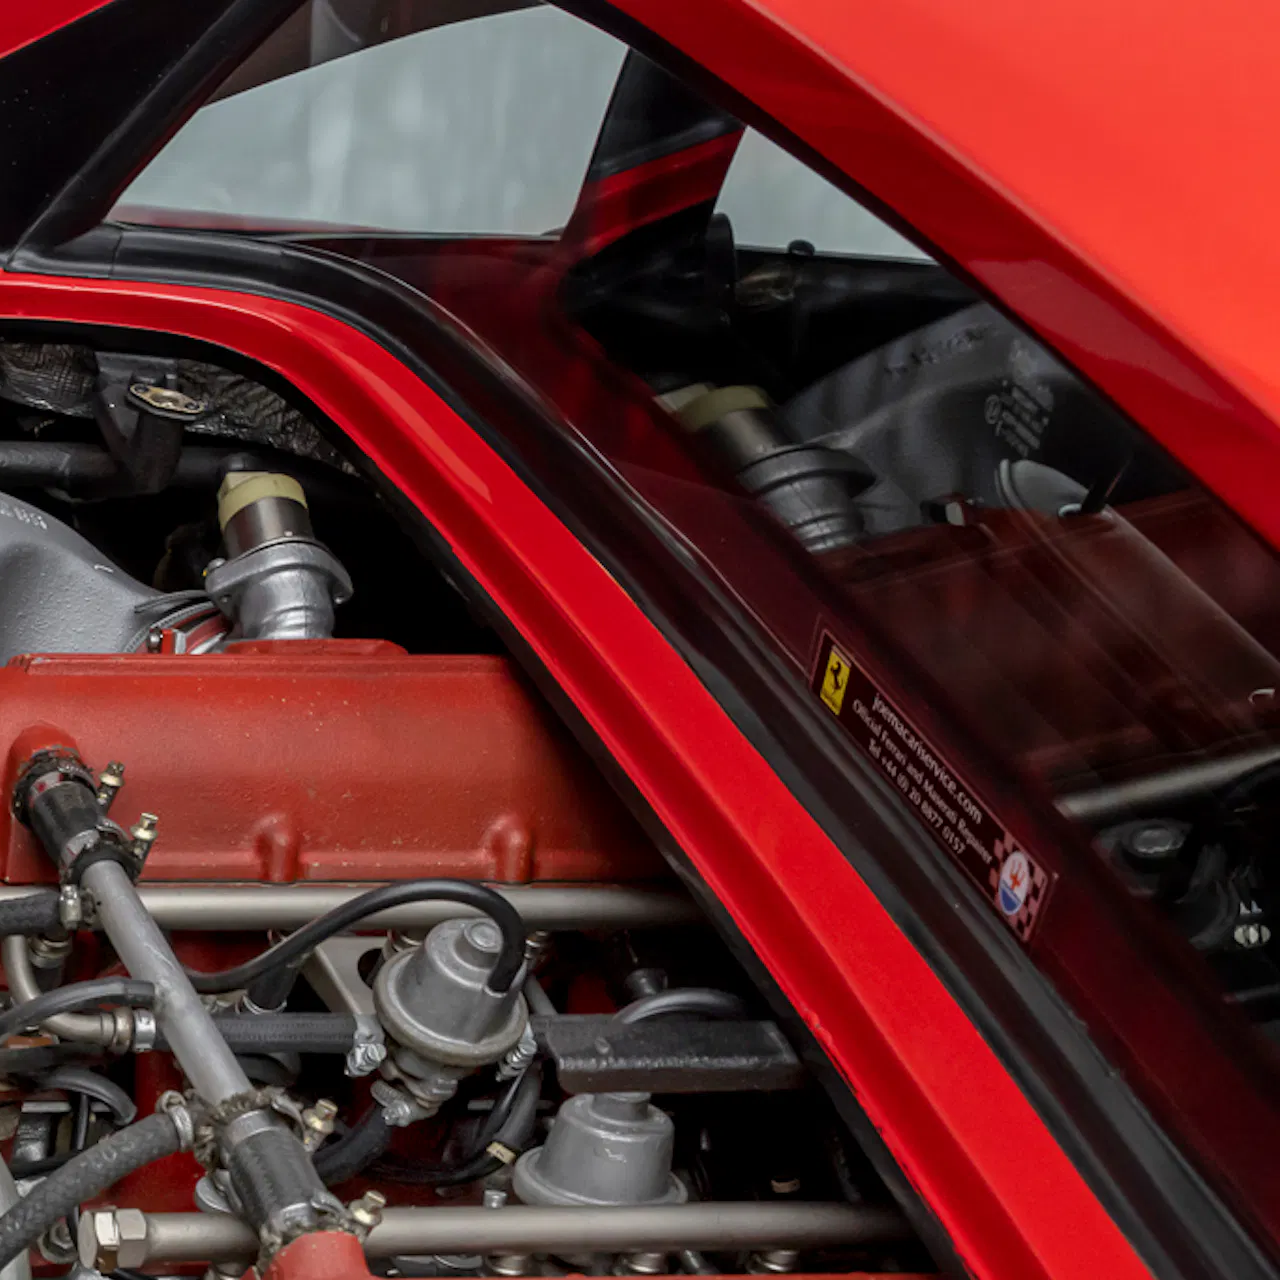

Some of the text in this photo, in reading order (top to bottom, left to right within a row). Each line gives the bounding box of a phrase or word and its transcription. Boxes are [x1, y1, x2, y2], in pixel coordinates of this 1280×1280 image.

[852, 698, 883, 737] Official
[881, 729, 907, 767] Ferrari
[922, 778, 958, 825] Maserati
[957, 817, 993, 865] Repairer
[868, 737, 882, 759] Tel
[872, 692, 982, 825] joemacariservice.com
